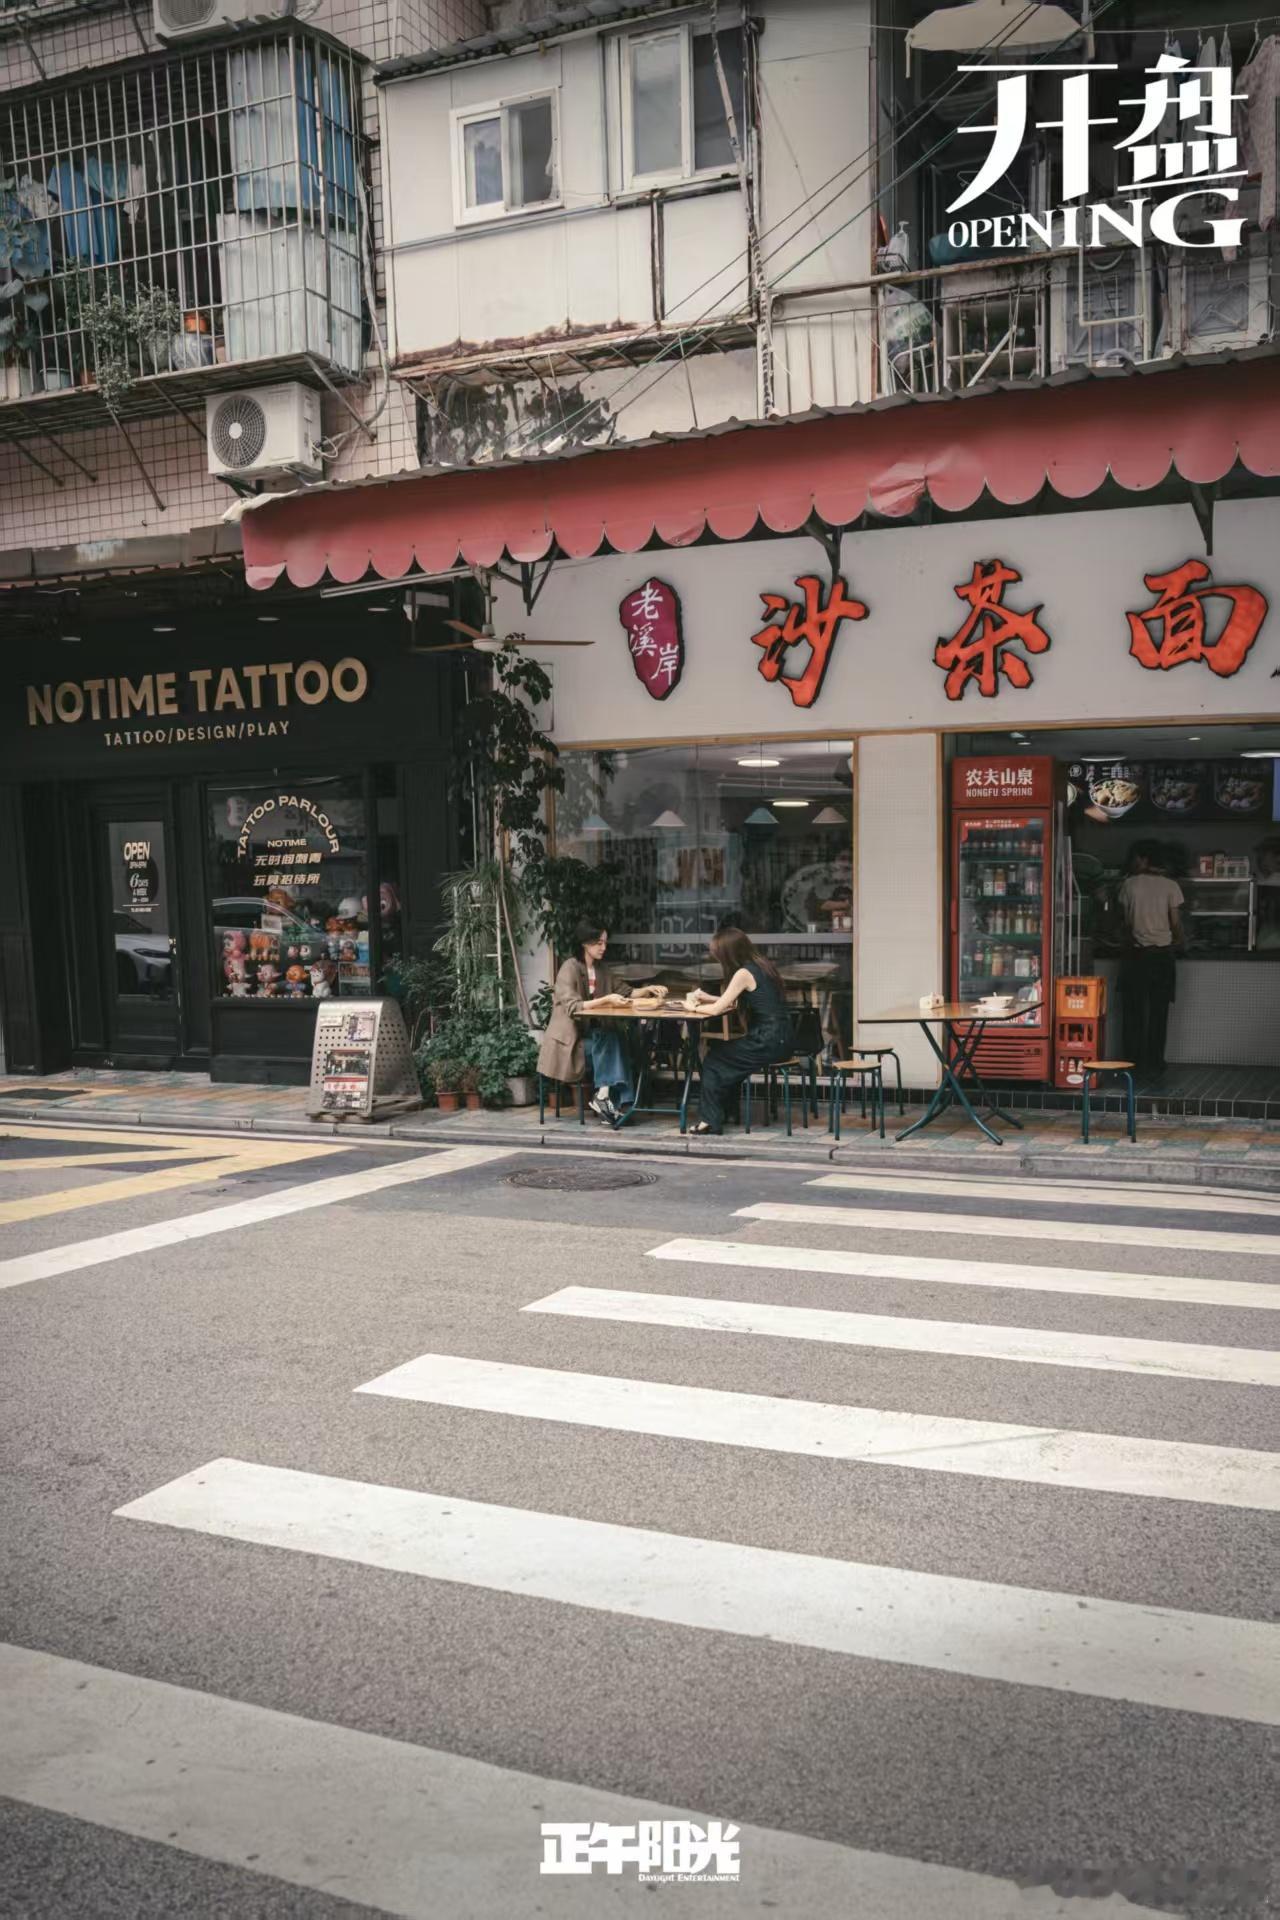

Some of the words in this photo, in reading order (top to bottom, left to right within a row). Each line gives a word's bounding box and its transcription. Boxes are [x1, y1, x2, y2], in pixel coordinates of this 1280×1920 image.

[629, 583, 680, 686] 老溪岸
[751, 559, 1269, 708] 沙茶面
[26, 672, 179, 726] NOTIME
[189, 657, 368, 713] TATTOO
[104, 721, 290, 746] TATTOO/DESIGN/PLAY
[965, 768, 1033, 786] 农夫山泉
[966, 787, 999, 797] NONGFU
[1001, 787, 1033, 796] SPRING
[237, 799, 276, 858] TATTOO
[278, 795, 340, 854] PARLOUR
[123, 841, 151, 861] OPEN
[267, 838, 307, 848] NOTIME
